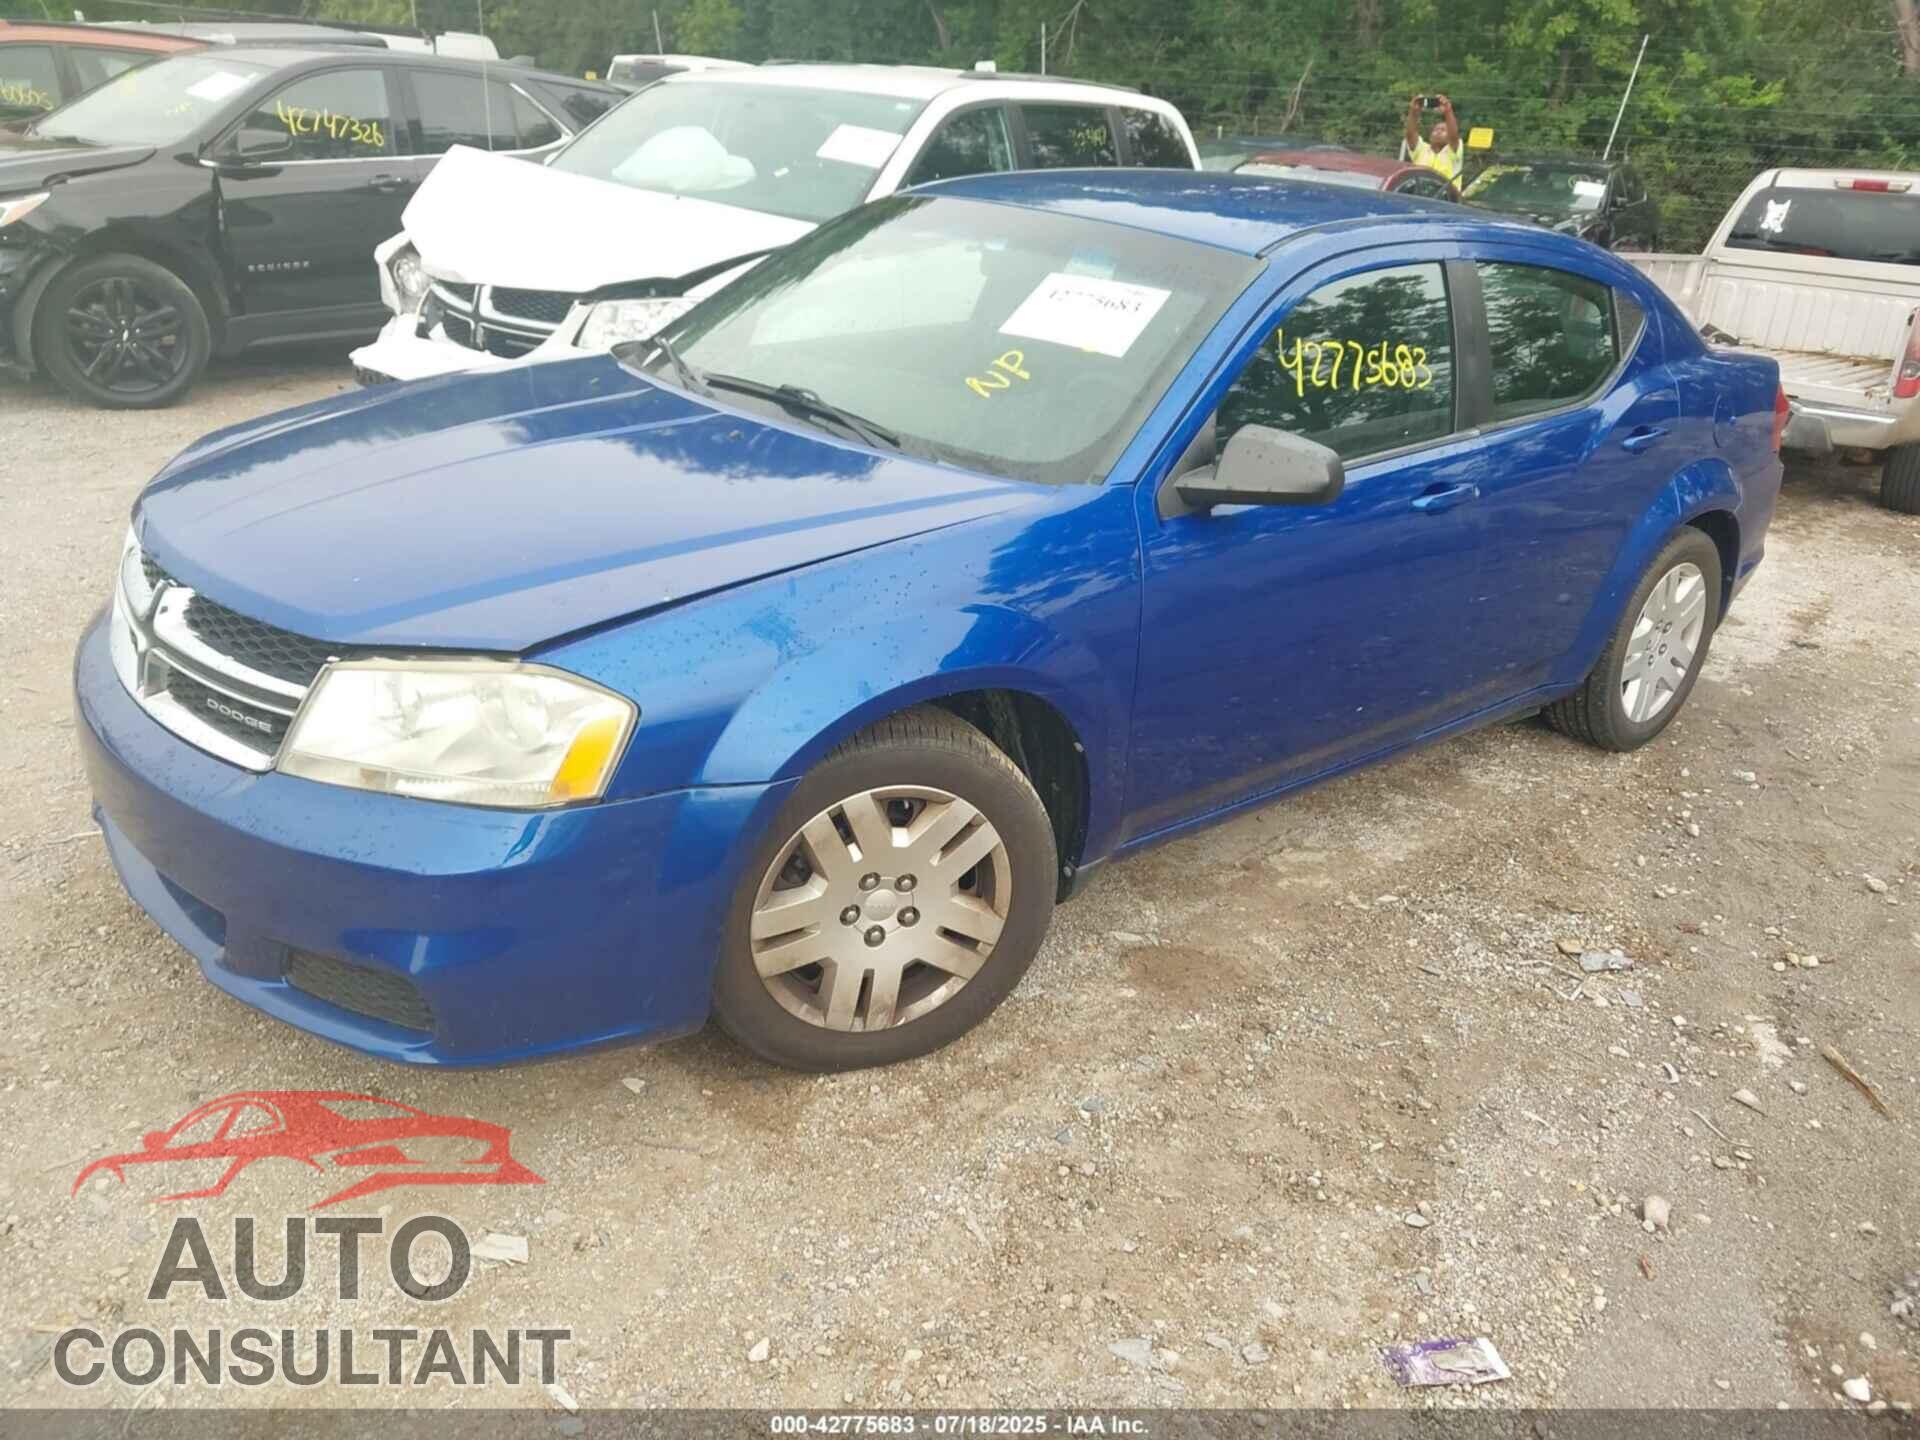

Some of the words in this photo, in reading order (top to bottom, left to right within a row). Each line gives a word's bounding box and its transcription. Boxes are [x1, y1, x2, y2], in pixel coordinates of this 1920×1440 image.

[965, 350, 1030, 398] NP
[1277, 328, 1433, 398] 42775683
[207, 698, 272, 733] DODGE
